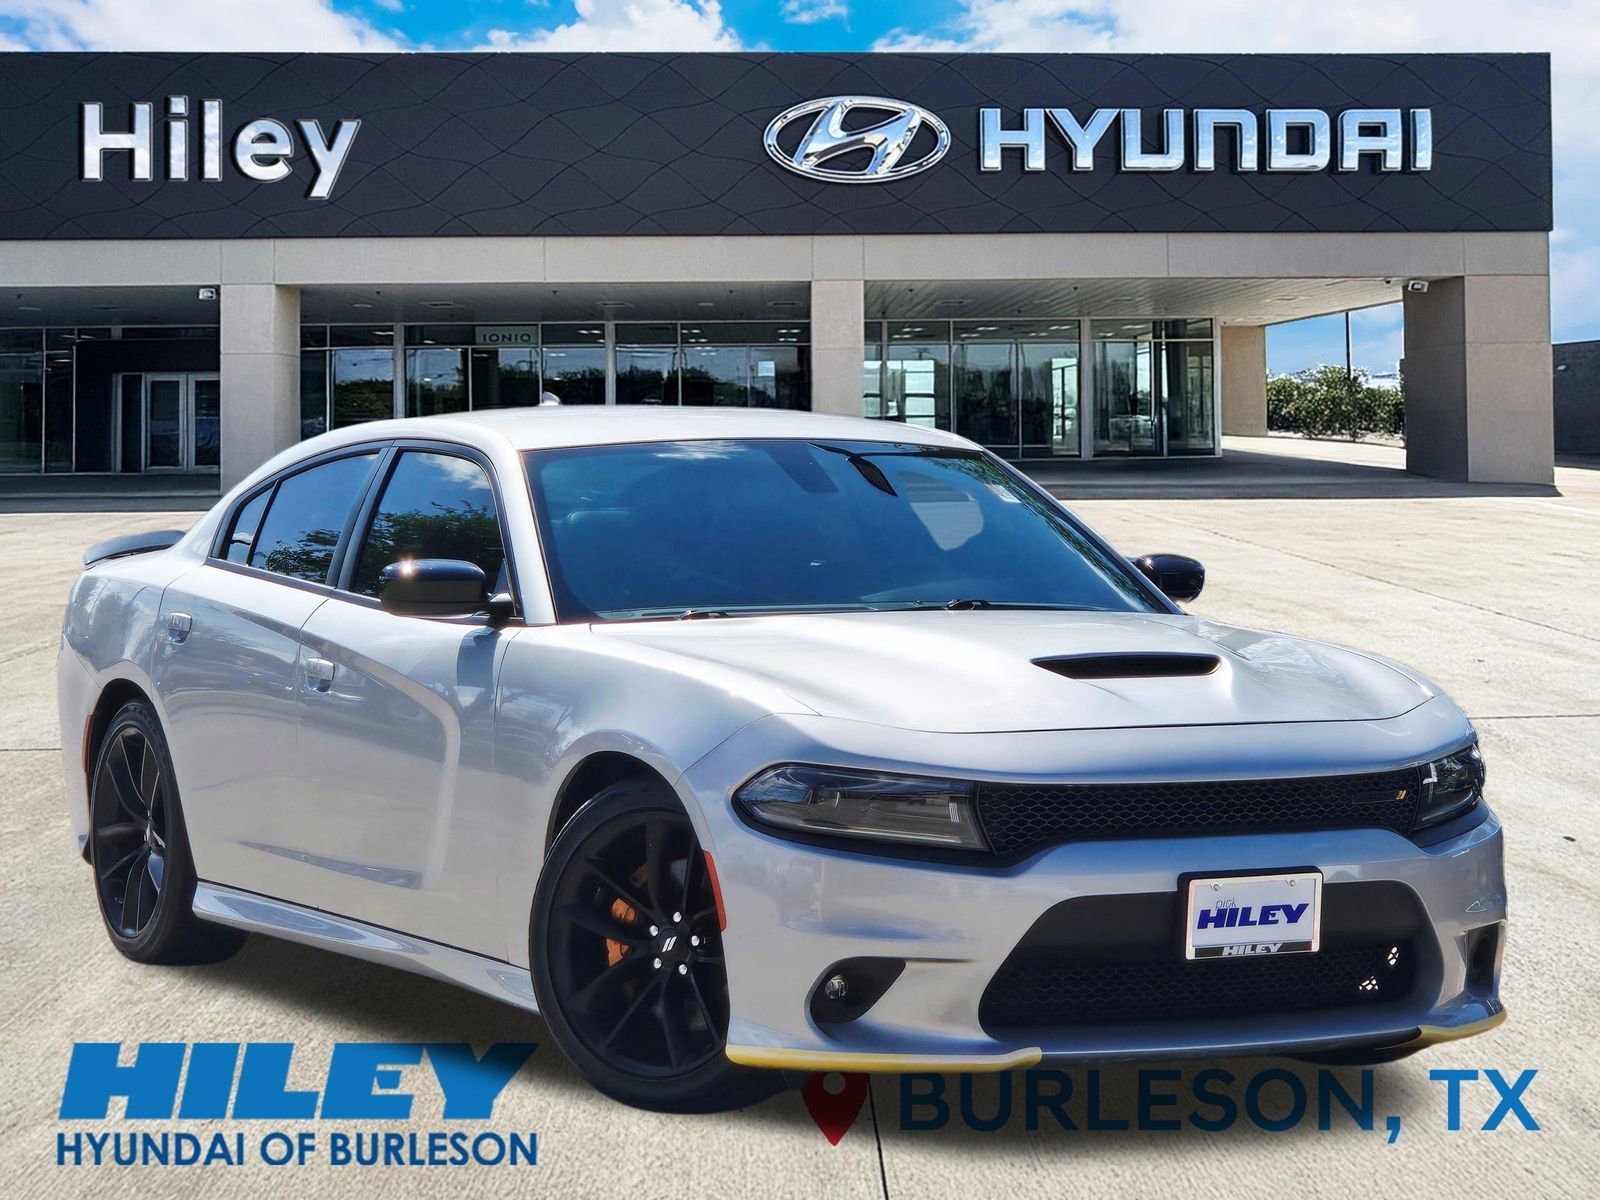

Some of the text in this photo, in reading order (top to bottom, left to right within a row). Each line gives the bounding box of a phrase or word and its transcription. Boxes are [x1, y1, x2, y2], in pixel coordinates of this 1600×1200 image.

[80, 95, 362, 200] Hiley
[977, 107, 1433, 173] HYUNDAI
[1197, 903, 1309, 929] HILEY
[1222, 943, 1284, 956] HILEY
